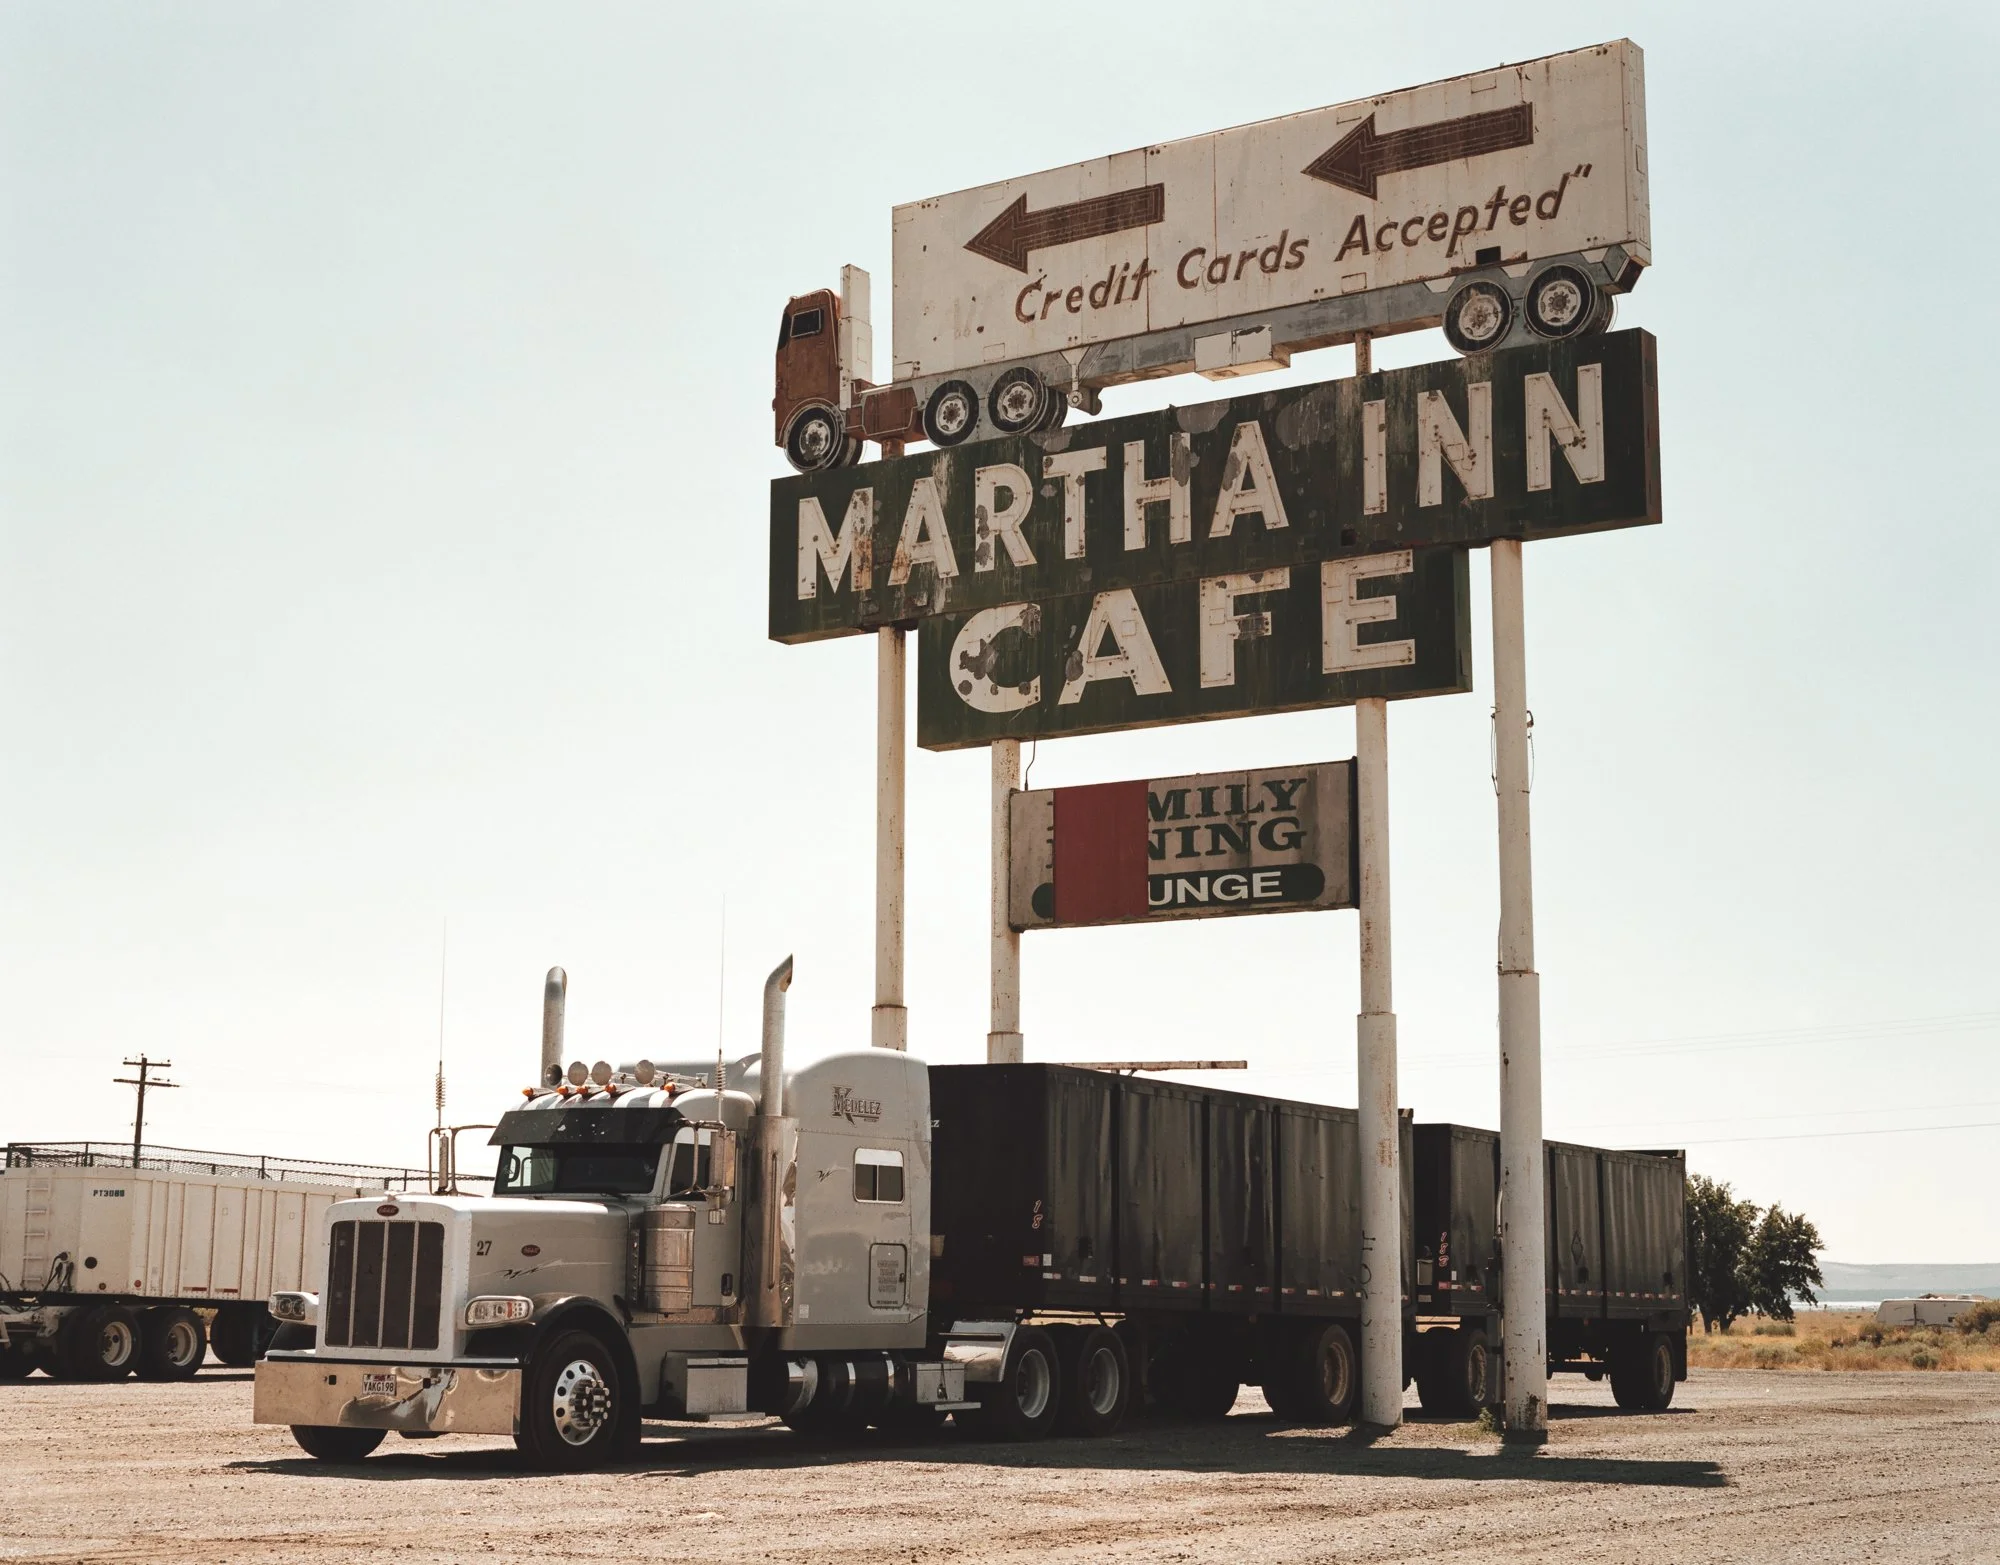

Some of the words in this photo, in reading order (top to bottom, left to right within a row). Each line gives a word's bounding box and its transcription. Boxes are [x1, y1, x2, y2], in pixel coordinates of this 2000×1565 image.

[1015, 257, 1152, 324] Credit
[1177, 229, 1308, 290] Cards
[797, 420, 1290, 600] MARTHA
[1363, 363, 1606, 516] INN
[949, 549, 1416, 713] CAFE
[1147, 777, 1307, 822] MILY
[1148, 871, 1283, 906] UNGE
[476, 1240, 492, 1256] 27
